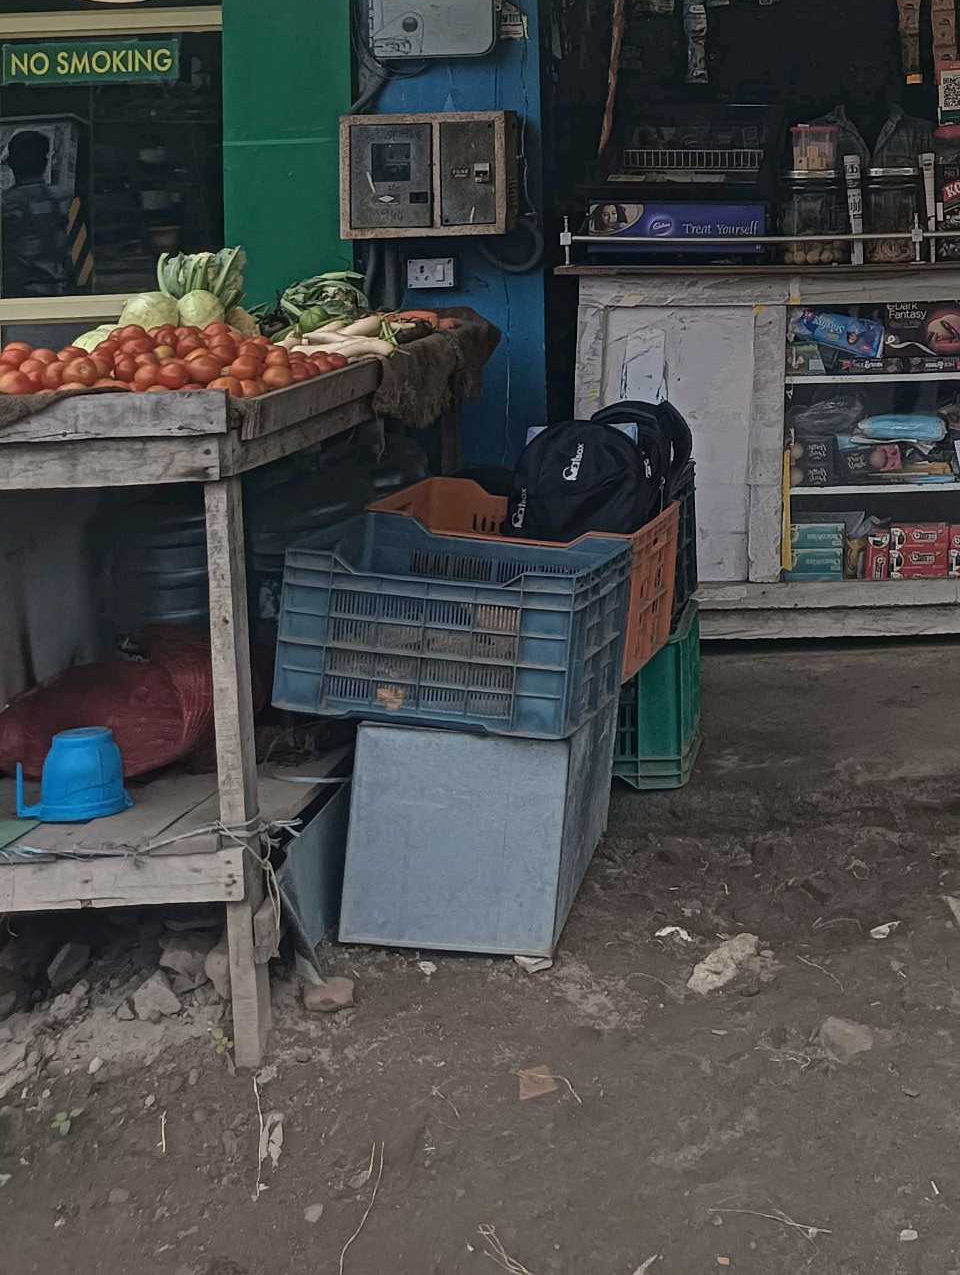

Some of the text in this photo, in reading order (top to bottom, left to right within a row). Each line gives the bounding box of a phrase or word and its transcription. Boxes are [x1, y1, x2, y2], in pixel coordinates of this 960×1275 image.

[10, 48, 173, 76] NO SMOKING
[682, 220, 759, 236] Treat Yourself
[889, 310, 927, 320] Fantasy
